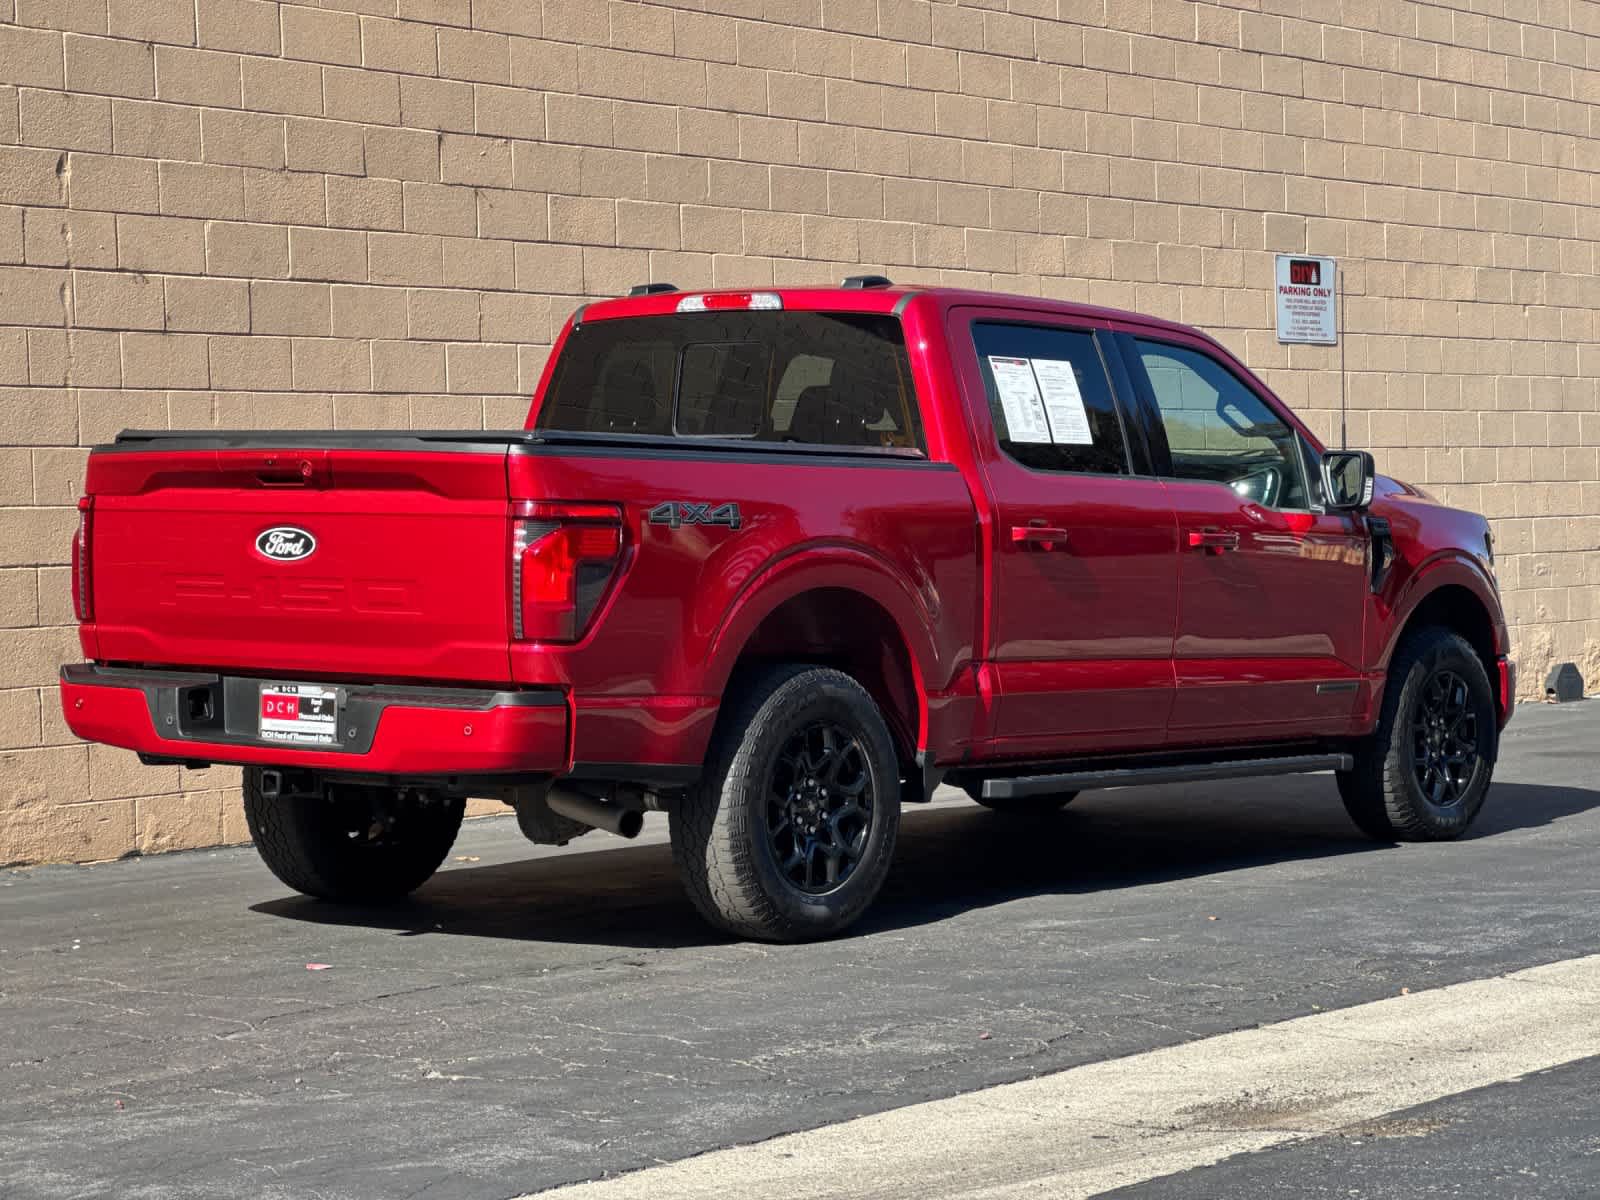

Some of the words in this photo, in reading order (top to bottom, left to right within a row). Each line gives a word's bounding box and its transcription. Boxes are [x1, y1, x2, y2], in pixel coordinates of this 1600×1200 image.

[1279, 285, 1311, 297] PARKING
[1313, 288, 1332, 297] ONLY
[264, 531, 304, 556] Ford
[160, 573, 424, 616] F-150
